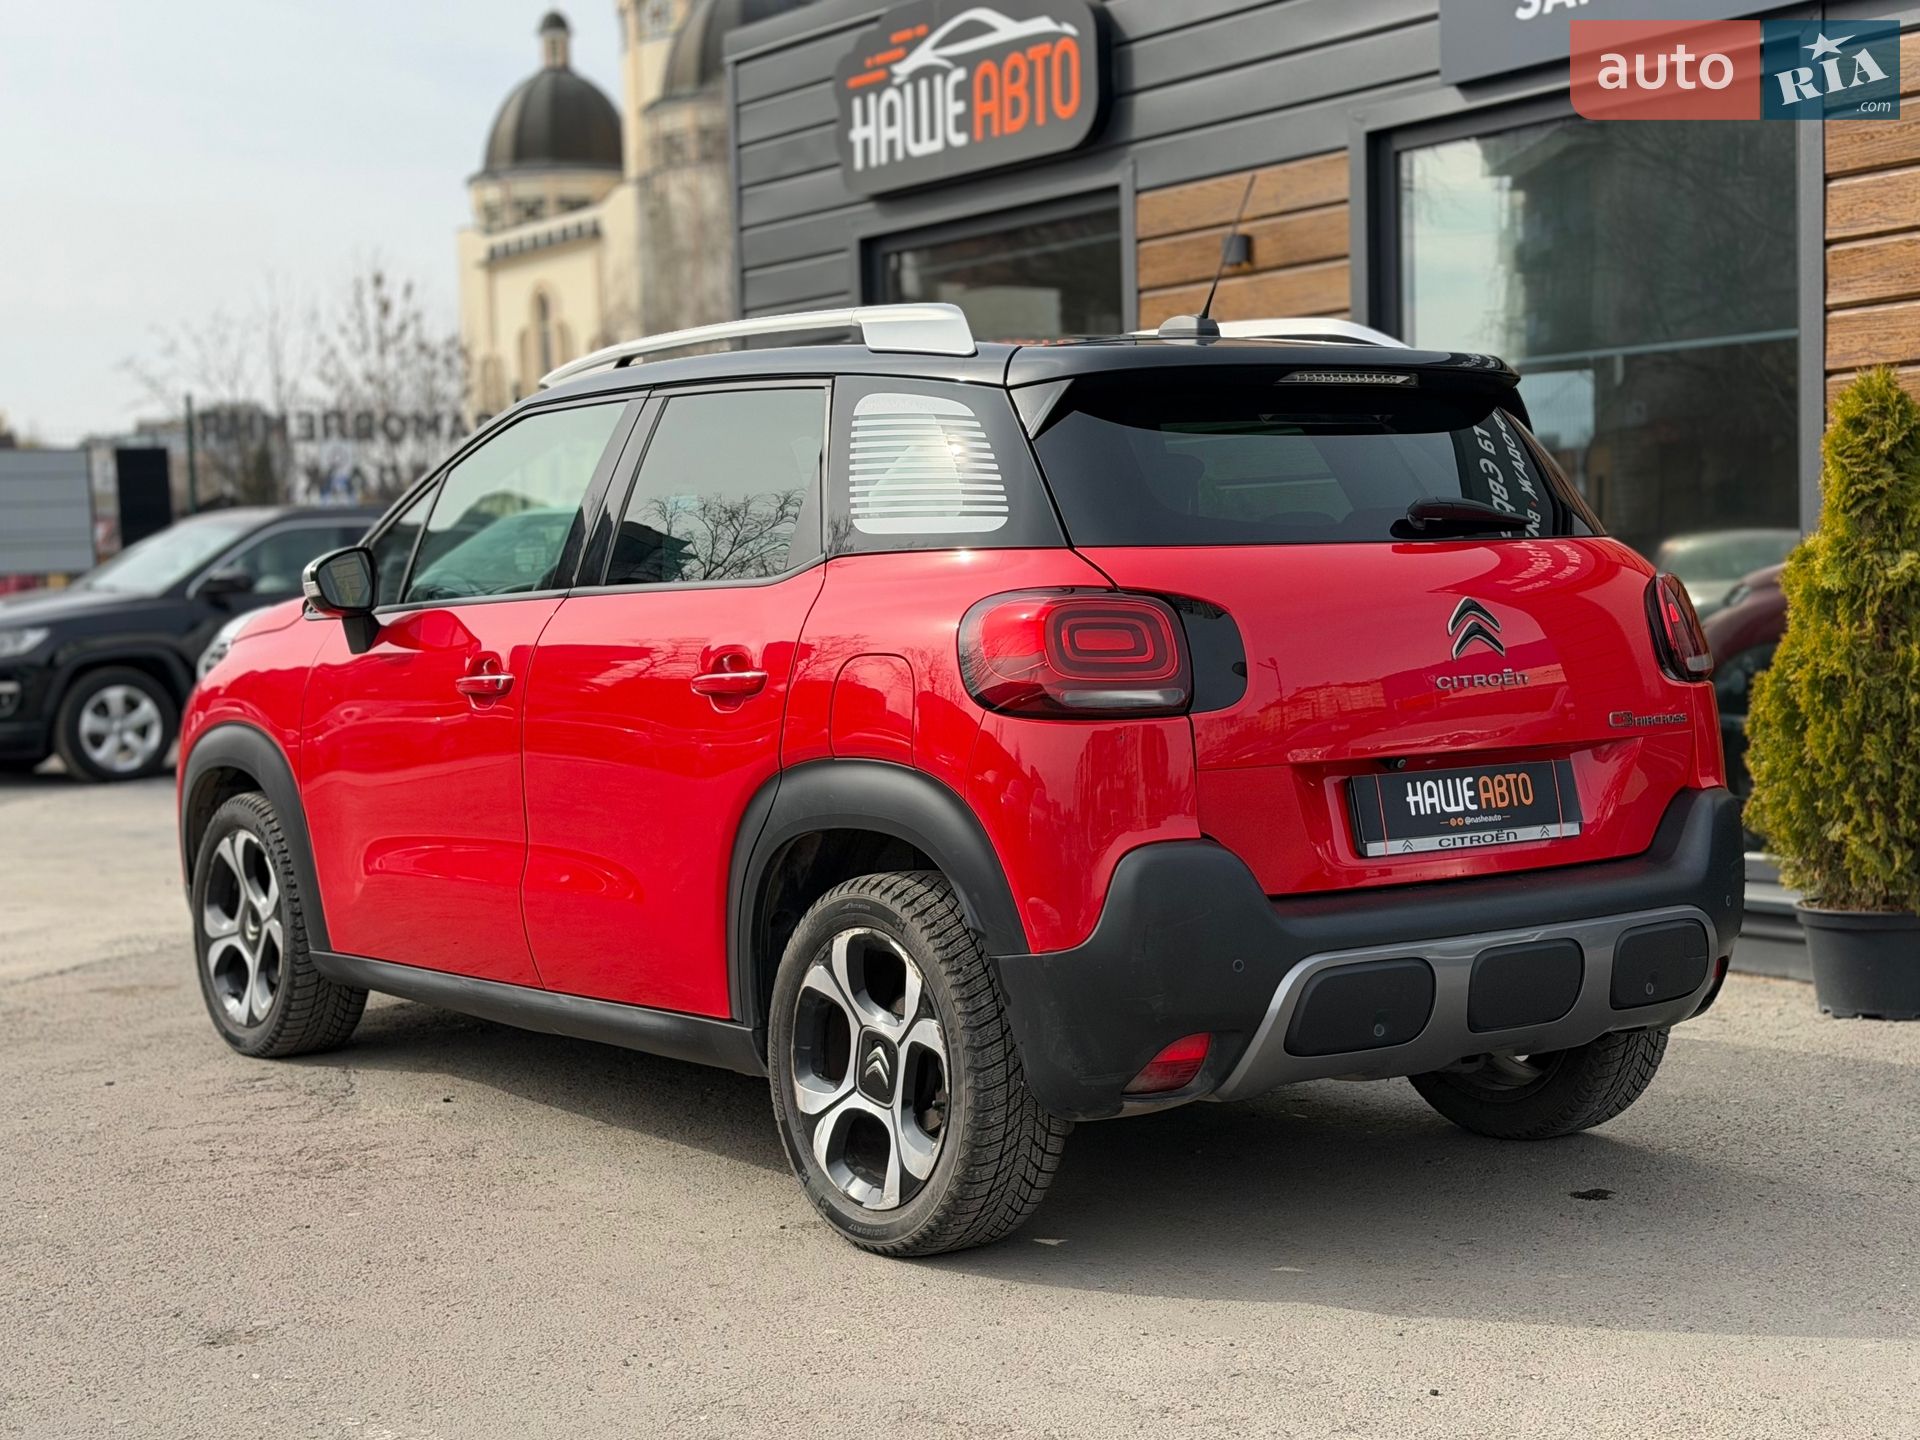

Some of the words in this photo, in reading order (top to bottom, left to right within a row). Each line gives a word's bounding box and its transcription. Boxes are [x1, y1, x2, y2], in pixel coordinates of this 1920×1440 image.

[848, 67, 968, 172] НАШЕ
[972, 36, 1081, 142] АВТО
[1406, 776, 1478, 816] НАШЕ
[1478, 772, 1534, 809] АВТО
